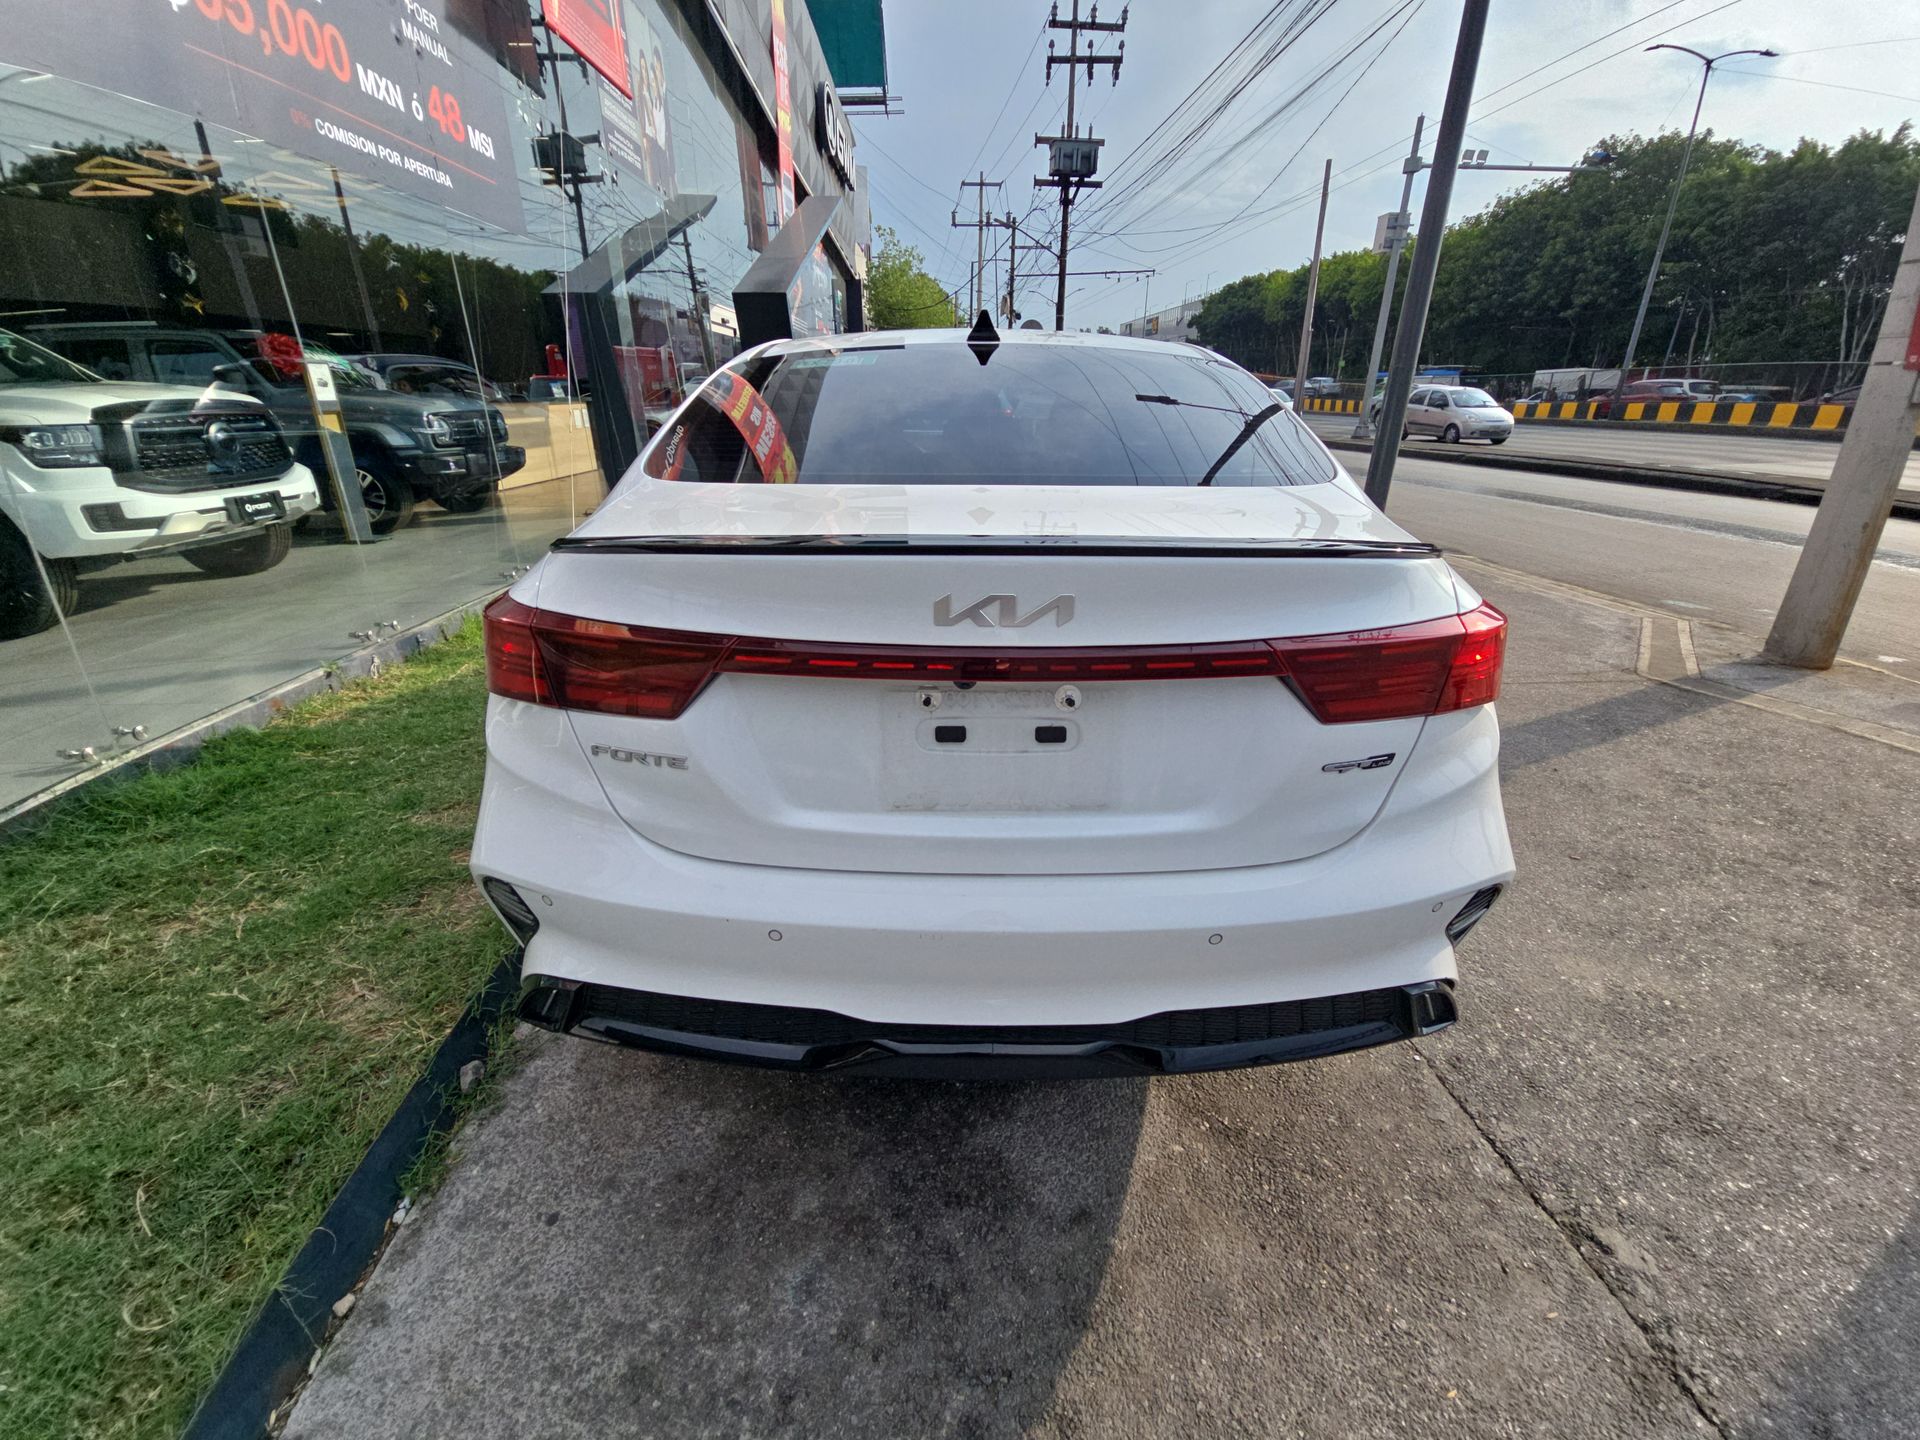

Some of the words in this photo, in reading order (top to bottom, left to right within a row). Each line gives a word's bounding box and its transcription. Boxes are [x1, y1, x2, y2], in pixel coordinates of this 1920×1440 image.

[401, 17, 453, 67] MANUAL
[356, 63, 405, 113] MXN
[428, 85, 465, 143] 48
[466, 124, 496, 160] MSI
[315, 113, 377, 157] COMISION
[378, 144, 402, 167] POR
[404, 156, 454, 189] APERTURA
[933, 593, 1076, 628] KIA
[590, 733, 689, 770] FORTE
